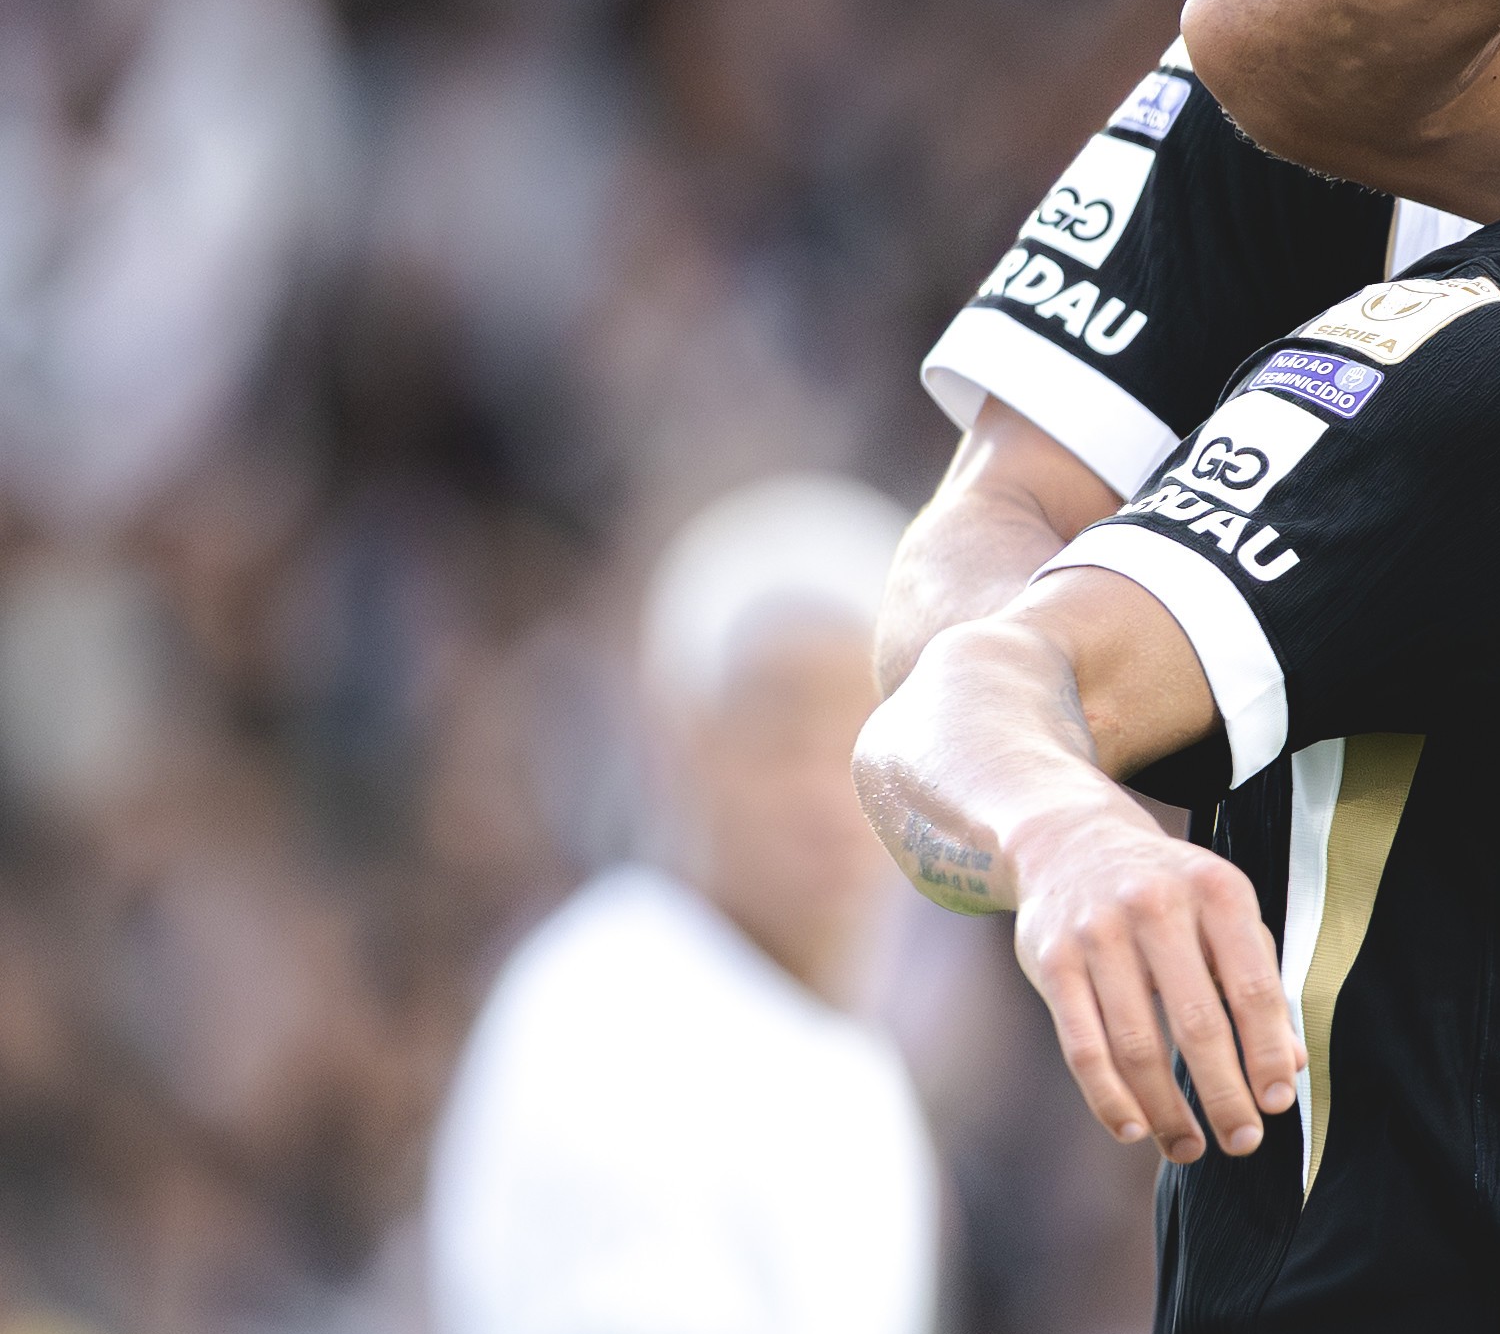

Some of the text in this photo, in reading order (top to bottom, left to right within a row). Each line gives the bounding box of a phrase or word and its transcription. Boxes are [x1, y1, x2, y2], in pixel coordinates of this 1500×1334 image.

[979, 248, 1148, 356] RDAU
[1314, 323, 1398, 355] SÉRIE A
[1272, 353, 1335, 376] NÃO AO
[1257, 371, 1356, 410] FEMINICÍDIO
